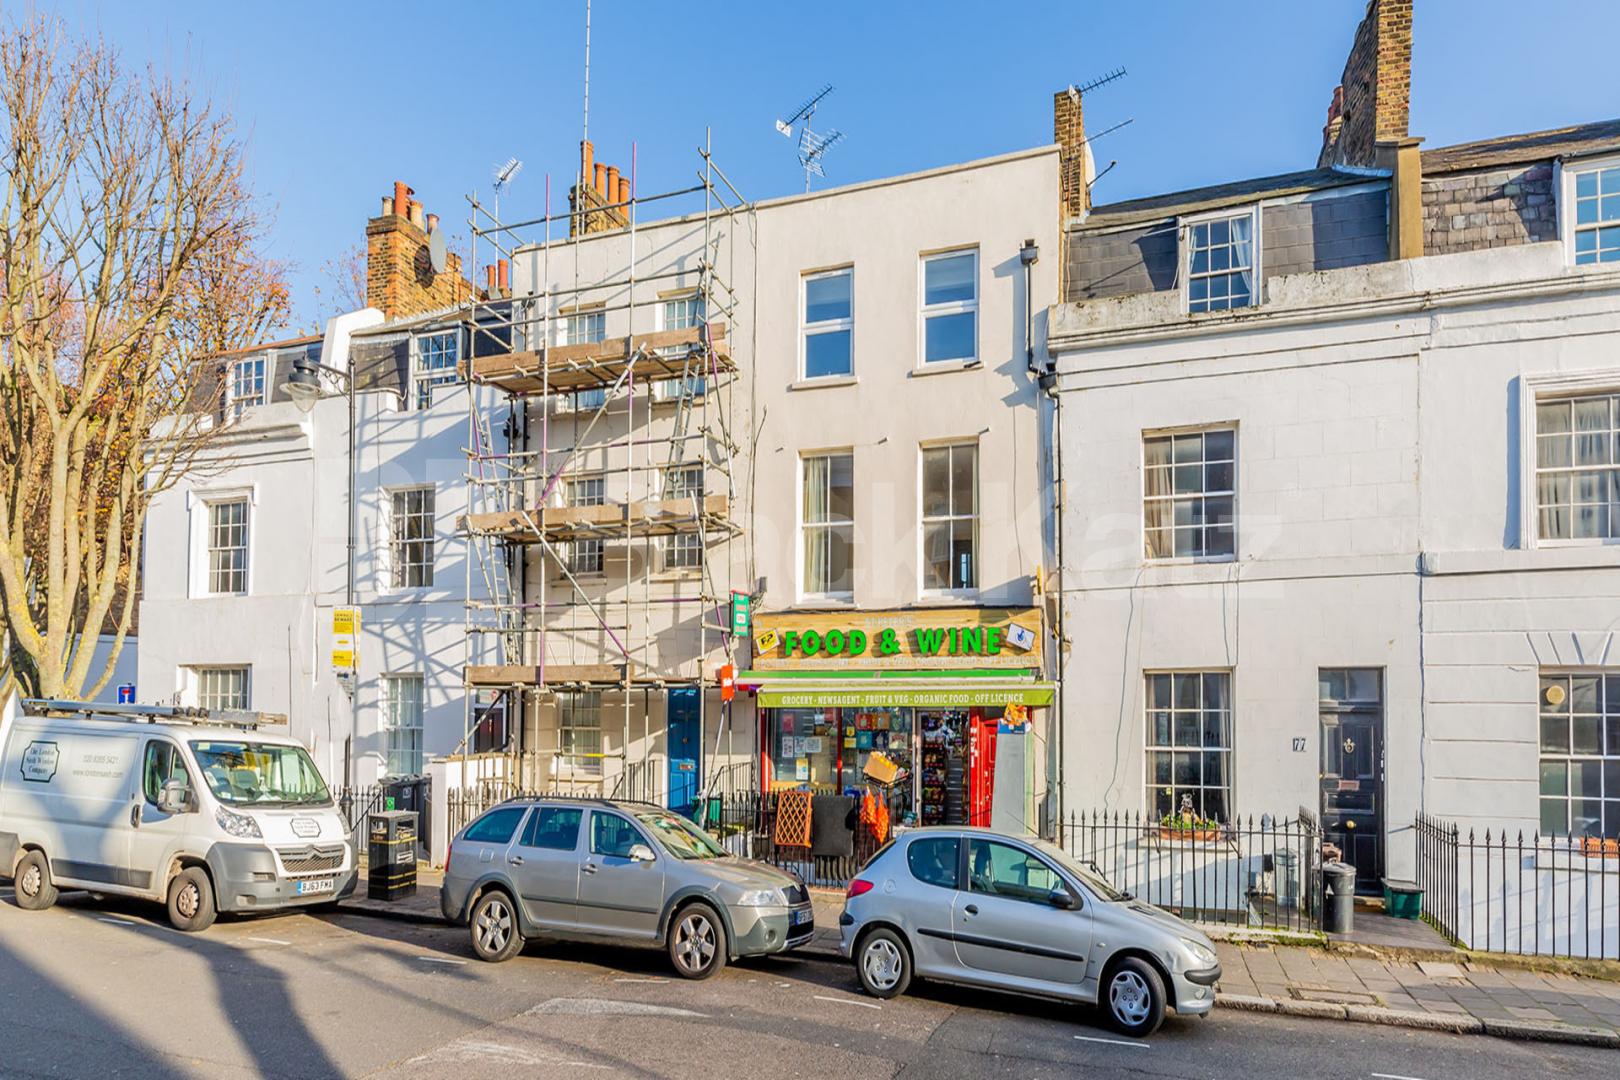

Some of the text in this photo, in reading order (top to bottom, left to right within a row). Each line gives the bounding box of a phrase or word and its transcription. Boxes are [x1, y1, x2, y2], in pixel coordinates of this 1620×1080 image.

[785, 626, 1001, 657] FOOD & WINE
[782, 695, 813, 705] GROCERY
[818, 695, 860, 705] NEWSAGENT
[865, 694, 887, 704] FRUIT
[894, 694, 908, 704] VEG
[914, 694, 947, 704] ORGANIC
[949, 694, 969, 703] FOOD
[975, 694, 989, 703] OFF
[991, 693, 1024, 703] LICENCE
